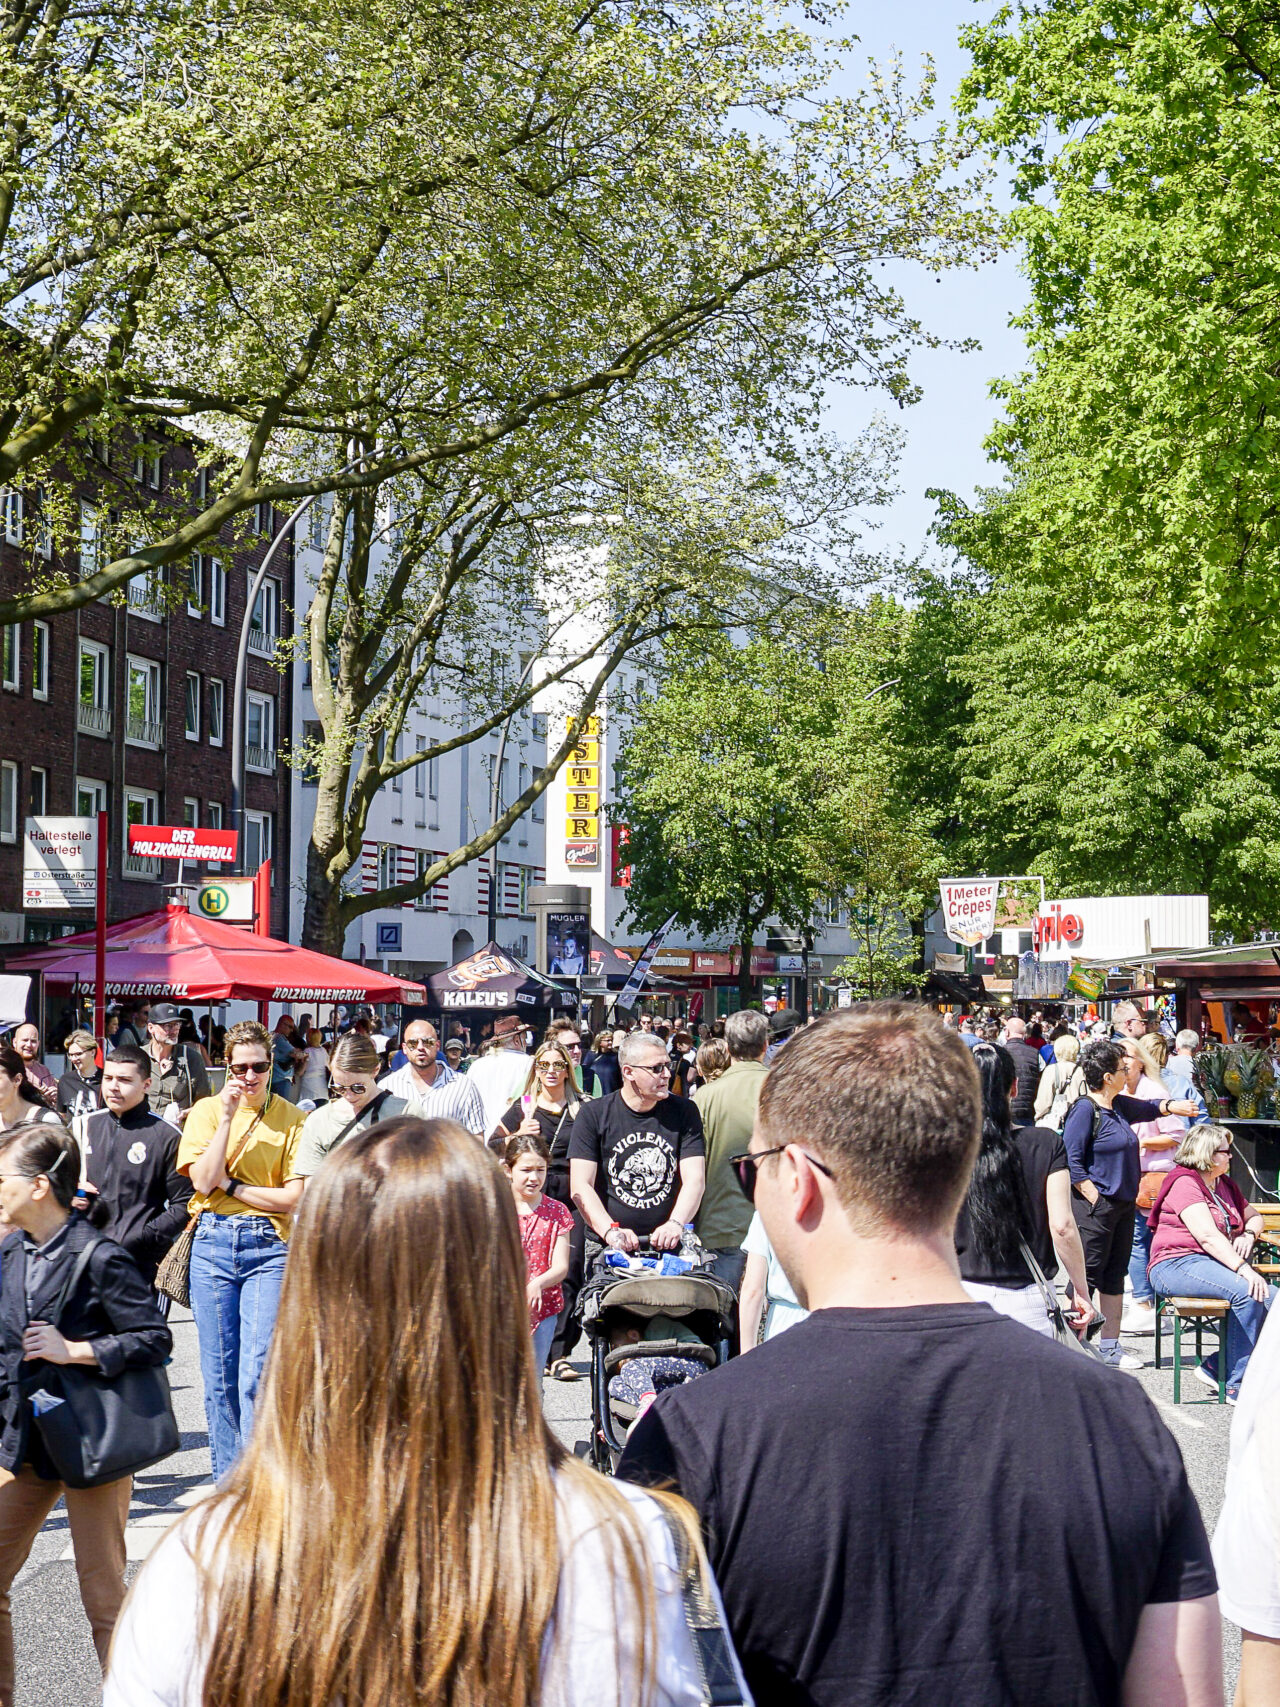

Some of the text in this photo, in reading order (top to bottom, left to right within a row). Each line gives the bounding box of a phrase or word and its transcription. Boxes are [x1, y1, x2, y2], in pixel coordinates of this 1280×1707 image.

[29, 830, 92, 841] Haltestelle
[172, 829, 195, 844] DER
[40, 845, 81, 856] verlegt
[132, 841, 233, 860] HOLZKOHLENGRILL
[566, 845, 596, 861] Grill
[206, 893, 221, 909] H
[946, 886, 993, 901] 1 Meter
[949, 898, 992, 918] Crêpes
[550, 914, 585, 922] MUGLER
[958, 916, 982, 929] NUR
[70, 982, 188, 997] HOLKOHLENGRILL
[272, 986, 366, 1001] HOLZKOHLENGRILL
[443, 991, 509, 1007] KALEU'S
[612, 1131, 674, 1154] VIOLENT
[615, 1184, 672, 1209] CREATURE
